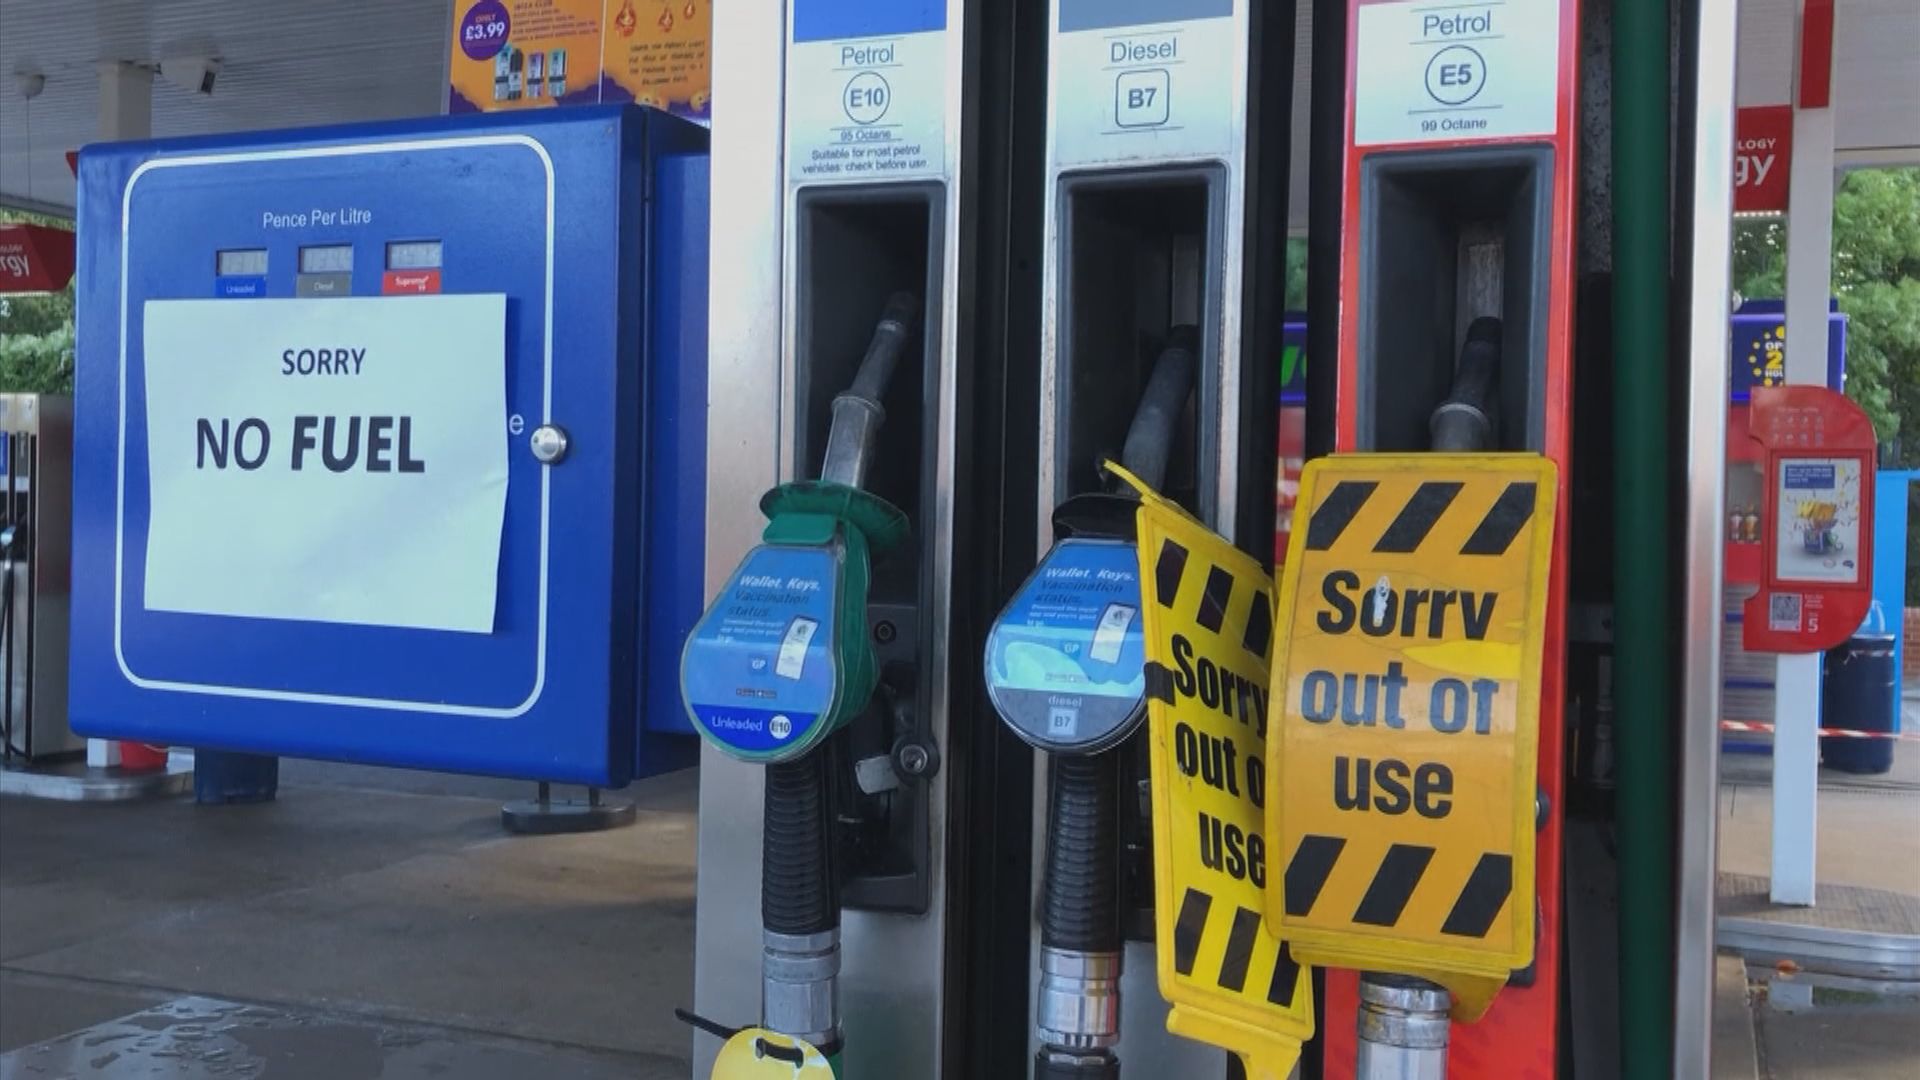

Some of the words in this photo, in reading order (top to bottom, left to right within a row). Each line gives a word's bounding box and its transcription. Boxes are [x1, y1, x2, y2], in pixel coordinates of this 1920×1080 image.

[465, 21, 505, 40] £3.99
[1424, 10, 1491, 36] Petrol
[841, 42, 894, 65] Petrol
[1111, 37, 1177, 62] Diesel
[1440, 64, 1472, 87] E5
[850, 88, 884, 107] E10
[1128, 88, 1157, 109] B7
[1421, 120, 1437, 132] 99
[1441, 118, 1487, 131] Octane
[855, 130, 891, 141] Octane
[1737, 138, 1776, 151] LOGY
[811, 149, 850, 160] Suitable
[852, 148, 865, 158] for
[867, 147, 892, 157] most
[893, 144, 921, 158] petrol
[845, 161, 874, 172] check
[876, 159, 907, 170] before
[1736, 154, 1776, 187] gy
[263, 212, 307, 229] Pence
[311, 209, 336, 226] Per
[340, 208, 372, 225] Litre
[0, 254, 29, 277] rgy
[282, 348, 366, 376] SORRY
[1766, 351, 1783, 369] 2
[196, 417, 270, 471] NO
[290, 415, 426, 473] FUEL
[740, 575, 782, 589] Wallet.
[787, 577, 821, 592] Keys.
[1046, 567, 1091, 578] Wallet.
[1097, 568, 1135, 581] Keys.
[1042, 580, 1123, 592] Vaccination
[735, 590, 810, 604] Vaccination
[1316, 570, 1498, 640] Sorry
[1808, 618, 1818, 633] 5
[1171, 634, 1268, 739] Sorry
[1048, 695, 1082, 707] diesel
[1300, 661, 1408, 730] out
[1429, 677, 1499, 735] of
[712, 715, 763, 732] Unleaded
[1054, 716, 1071, 728] B7
[1175, 722, 1240, 799] out
[1246, 753, 1266, 810] o
[1333, 756, 1454, 819] use
[1199, 812, 1266, 889] use
